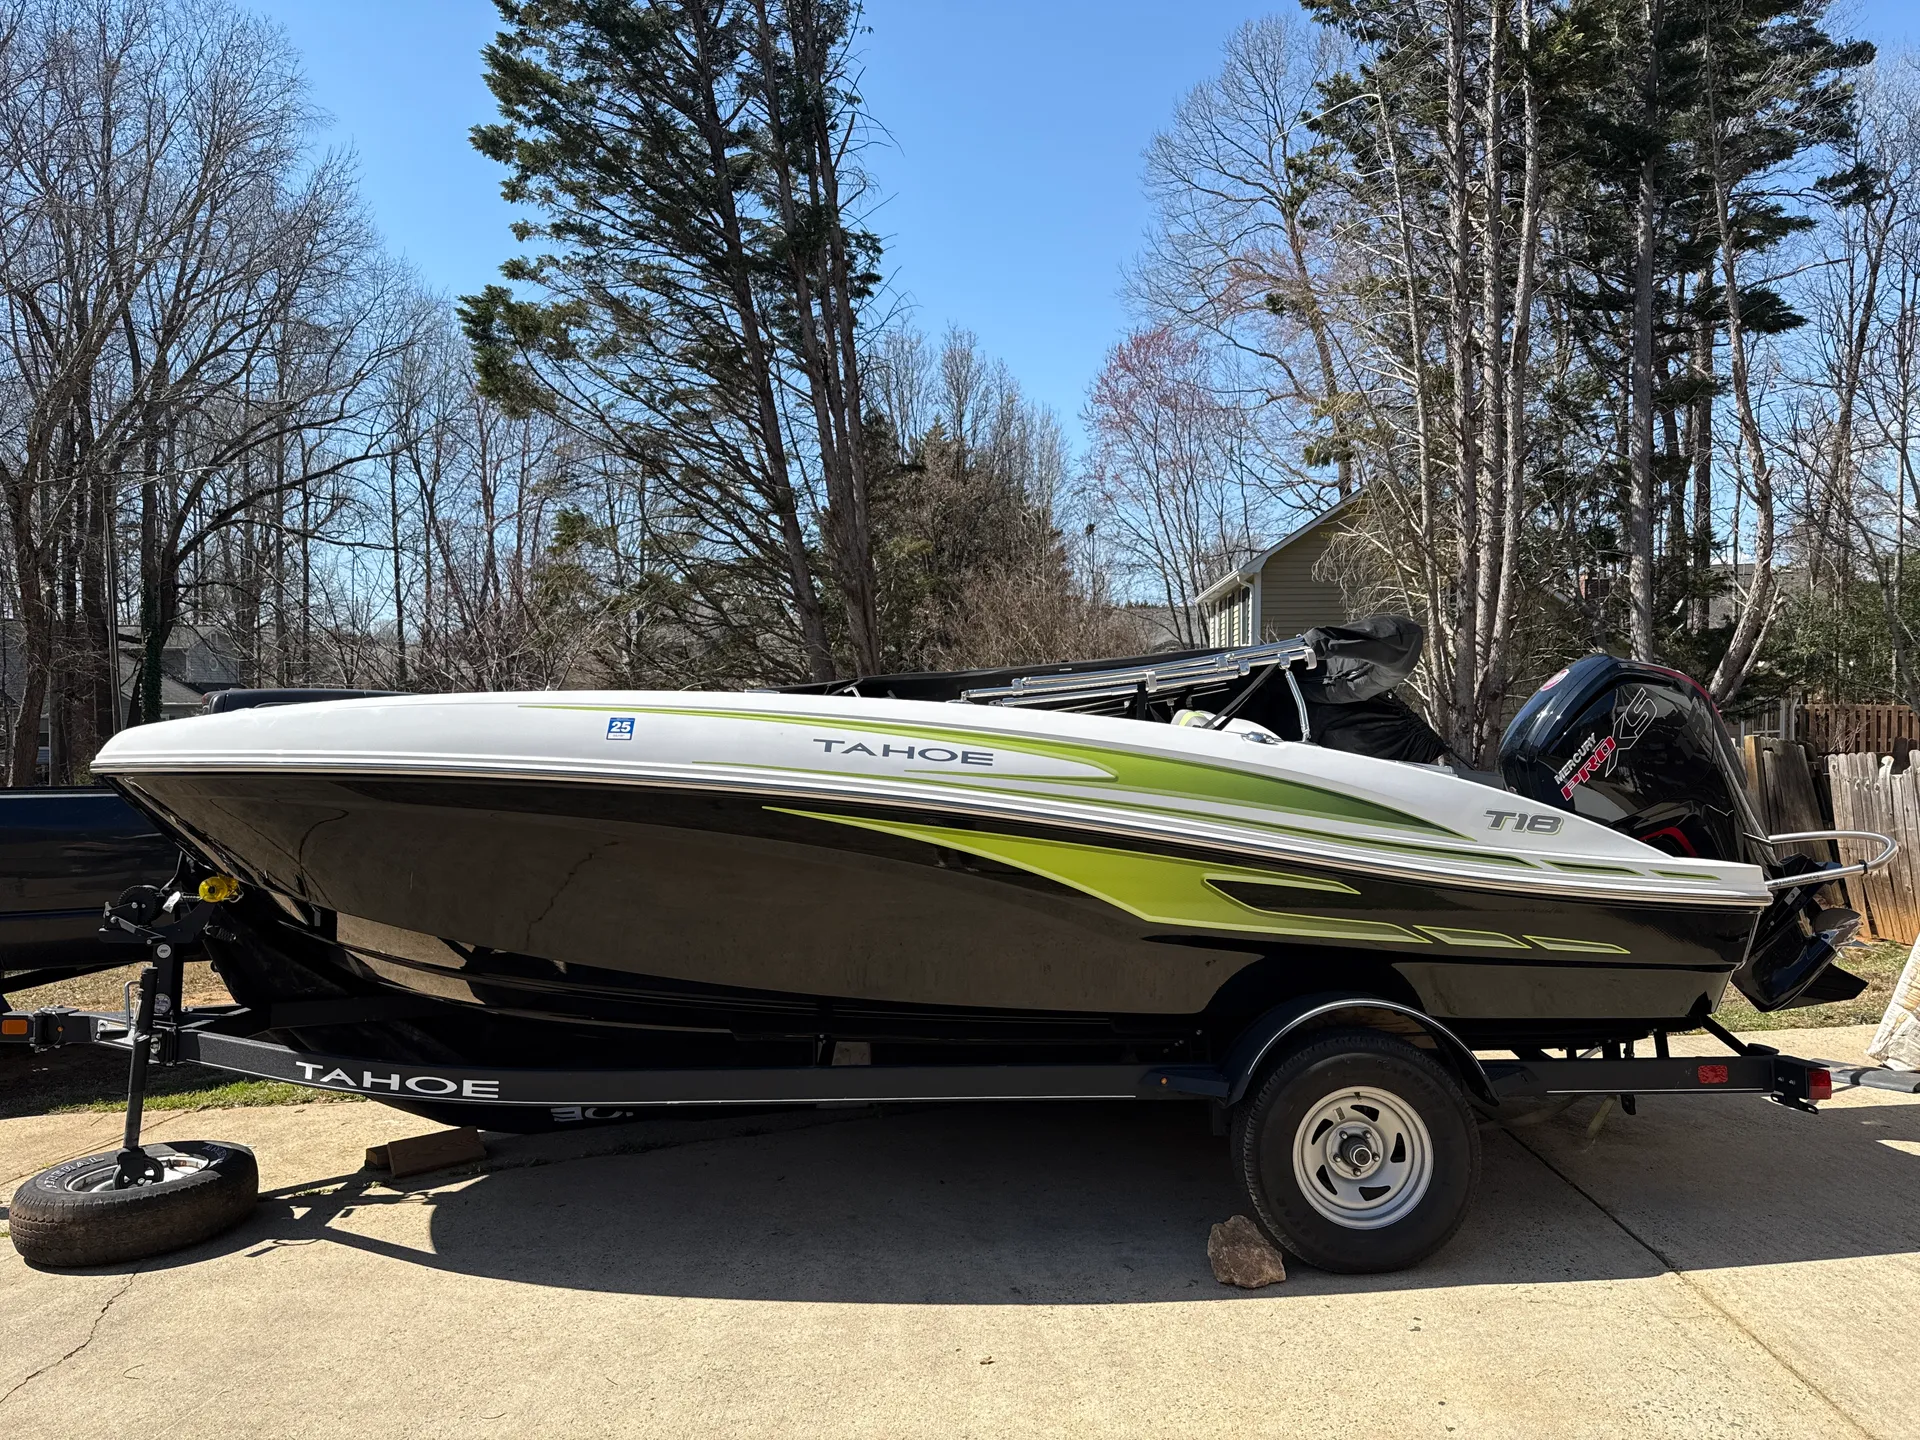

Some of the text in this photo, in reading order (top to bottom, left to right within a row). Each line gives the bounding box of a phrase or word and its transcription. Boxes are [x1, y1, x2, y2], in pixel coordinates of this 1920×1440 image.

[610, 721, 631, 732] 25
[813, 738, 994, 766] TAHOE
[1554, 732, 1597, 785] MERCURY
[1560, 687, 1658, 801] PRO XS
[1484, 808, 1564, 835] T18
[295, 1061, 499, 1098] TAHOE
